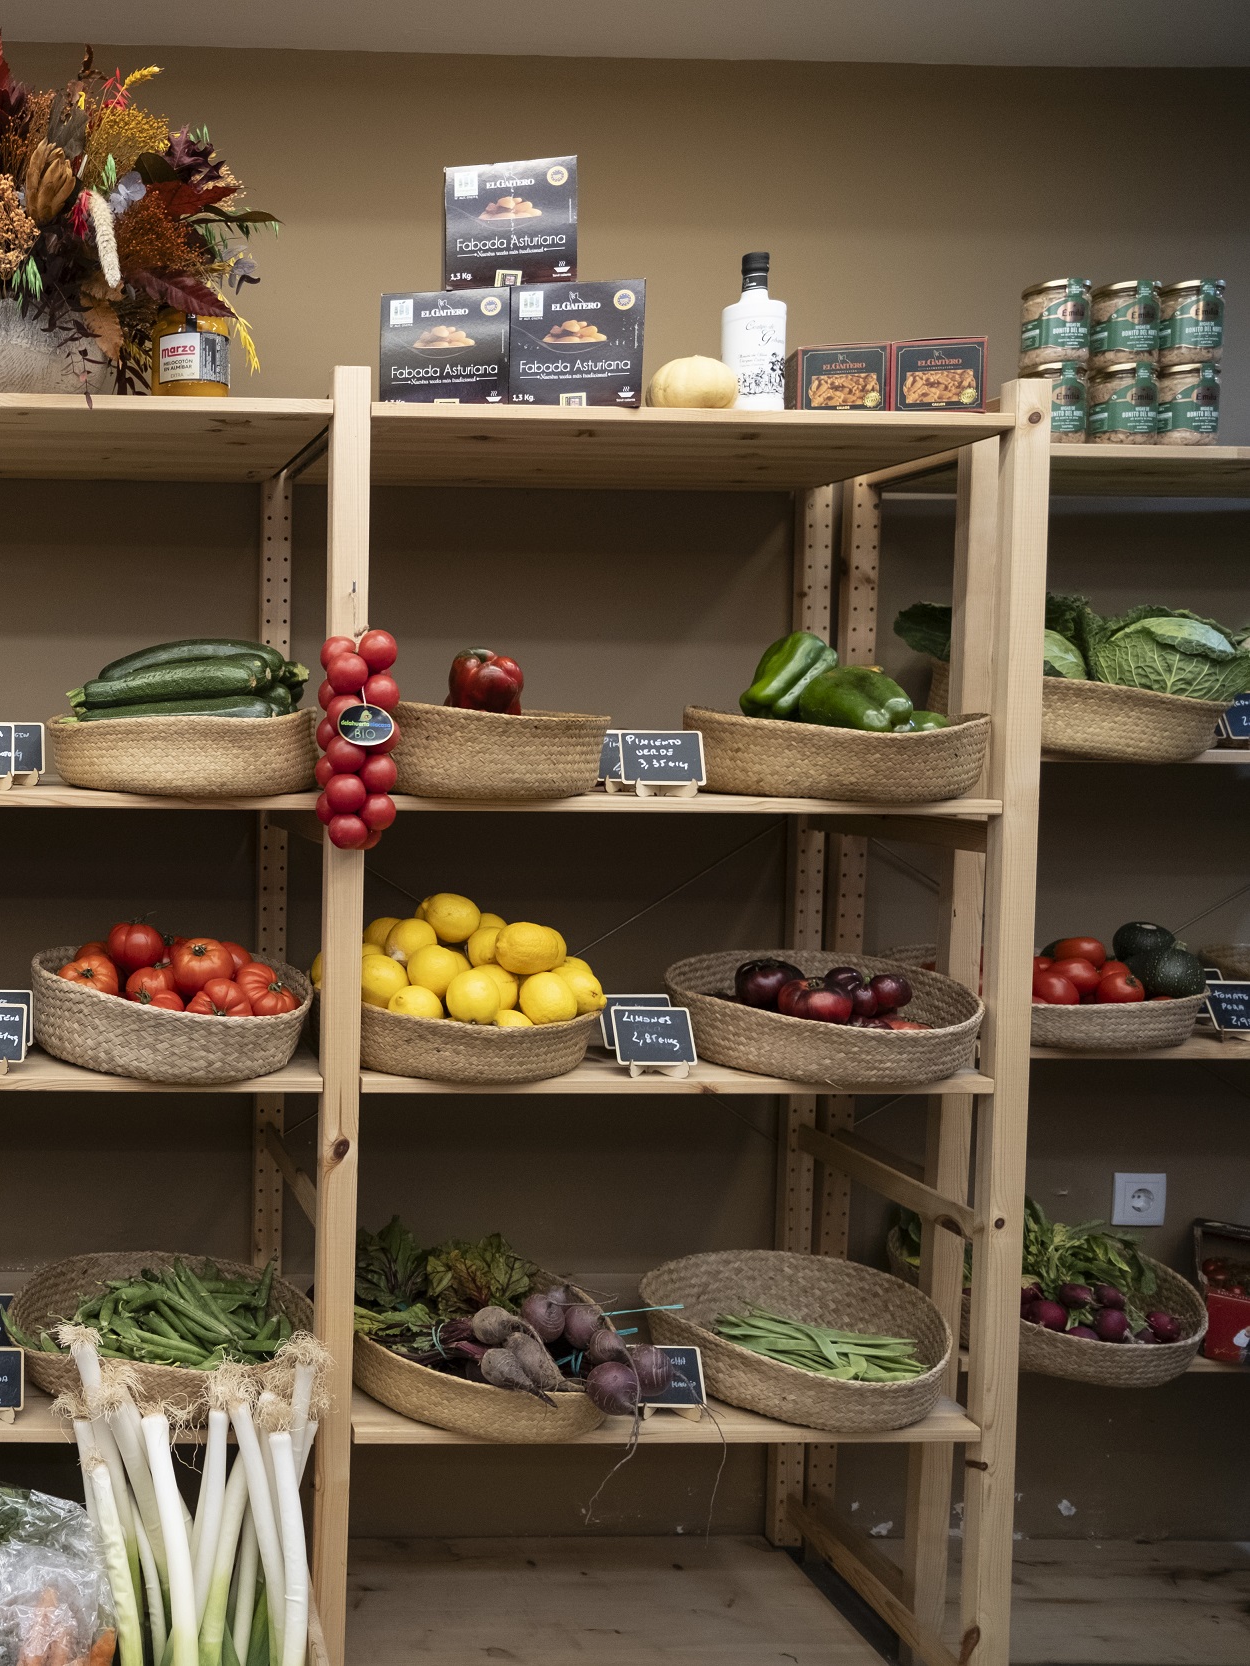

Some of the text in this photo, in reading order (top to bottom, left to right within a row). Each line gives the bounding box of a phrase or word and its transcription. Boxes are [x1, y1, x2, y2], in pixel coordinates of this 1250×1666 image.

[457, 235, 565, 251] Fabada Asturiana
[450, 272, 460, 280] 1,3
[162, 345, 195, 359] marzo
[391, 364, 498, 378] Fabada Asturiana
[520, 359, 631, 373] Fabada Asturiana
[512, 394, 523, 402] 1,3
[355, 729, 375, 739] BIO
[625, 735, 681, 746] PIMIENTO
[623, 1012, 672, 1024] LIMONES
